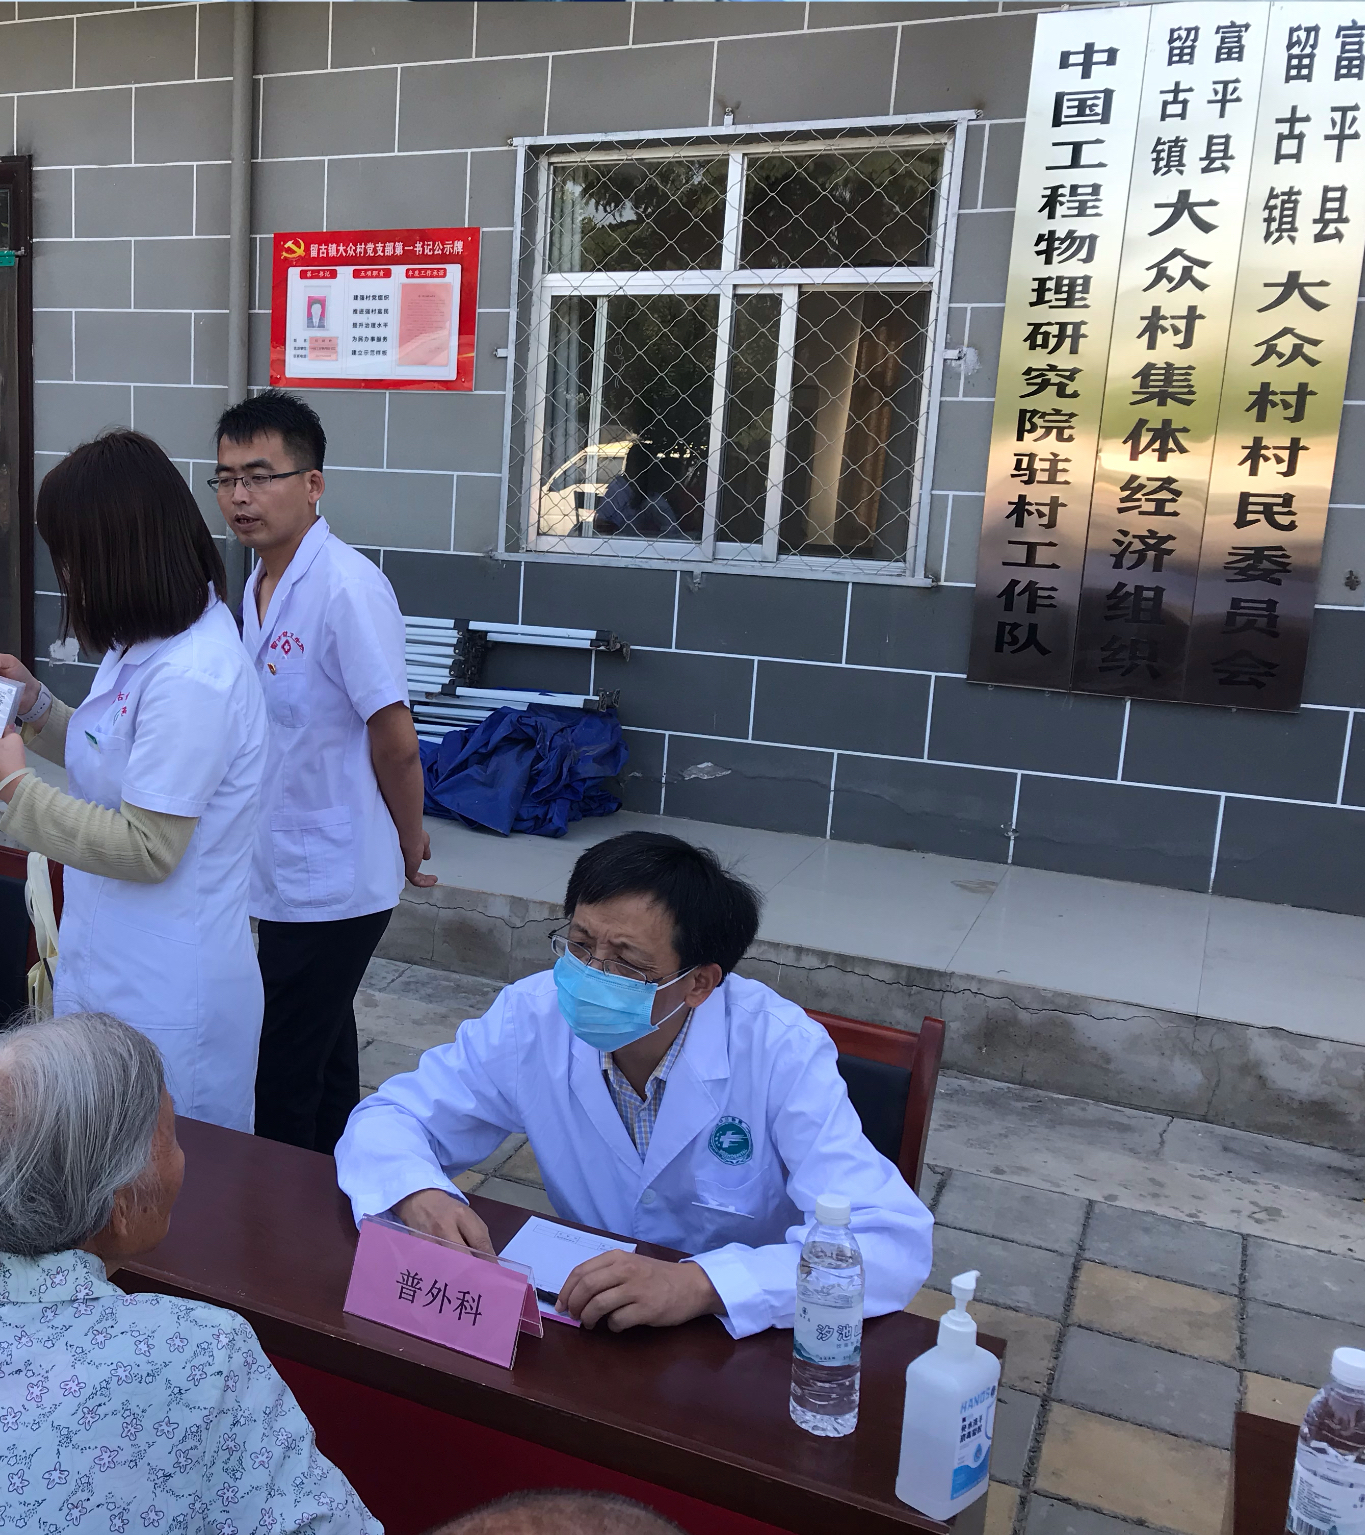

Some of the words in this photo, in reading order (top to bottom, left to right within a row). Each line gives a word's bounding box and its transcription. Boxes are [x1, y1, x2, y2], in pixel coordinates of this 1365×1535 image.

[1151, 24, 1201, 178] 留古镇
[1198, 20, 1252, 175] 富平县
[1262, 21, 1321, 246] 留古镇
[310, 240, 464, 258] 留古镇大众村党支部第一书记公示牌
[994, 41, 1120, 658] 中国工程物理研究院驻村工作队
[1098, 188, 1221, 681] 大众村集体经济组织
[1211, 269, 1333, 692] 大众村村民委员会
[395, 1267, 483, 1328] 普外科
